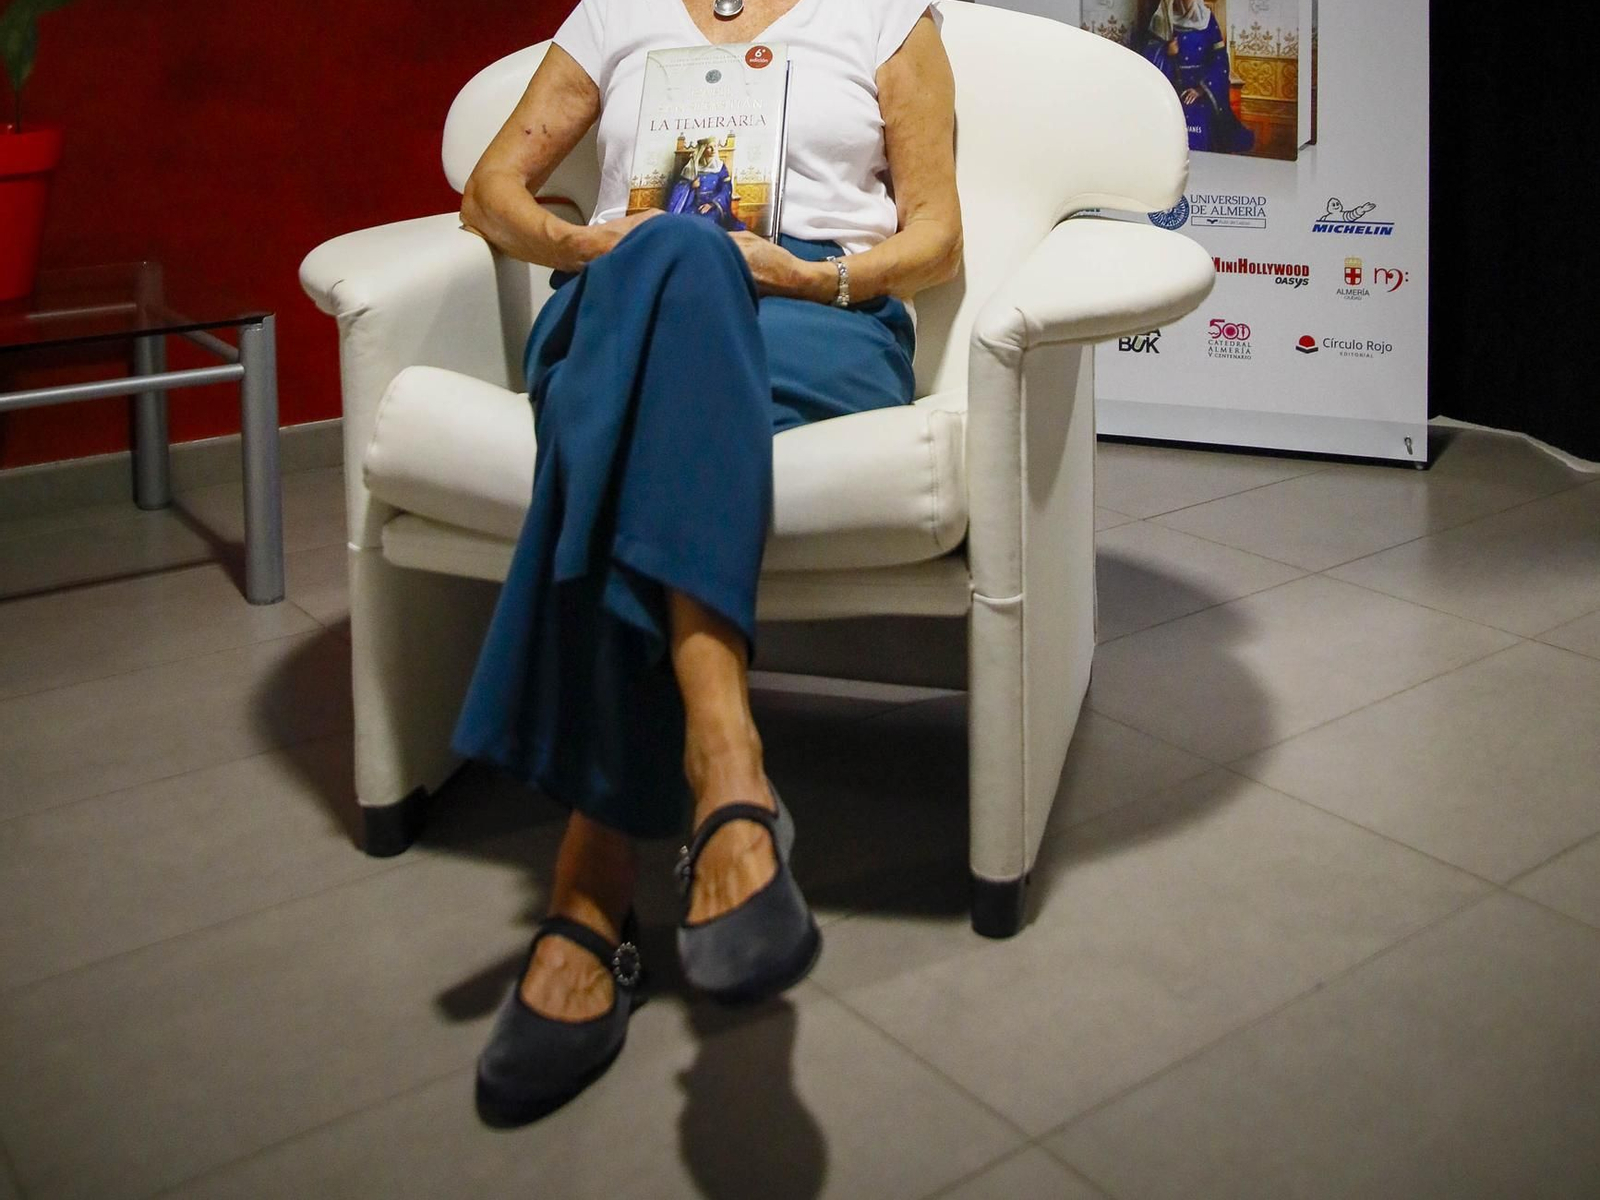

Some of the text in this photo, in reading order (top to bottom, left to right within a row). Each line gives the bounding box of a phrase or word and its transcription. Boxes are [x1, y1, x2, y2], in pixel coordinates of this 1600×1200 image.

[651, 114, 767, 131] LA TEMERARIA
[1190, 194, 1267, 206] UNIVERSIDAD
[1190, 204, 1266, 217] DE ALMERÍA
[1312, 223, 1393, 236] MICHELIN
[1336, 287, 1370, 296] ALMERÍA
[1118, 335, 1160, 354] BUK
[1208, 346, 1251, 354] ALMERÍA
[1322, 337, 1393, 354] Círculo Rojo
